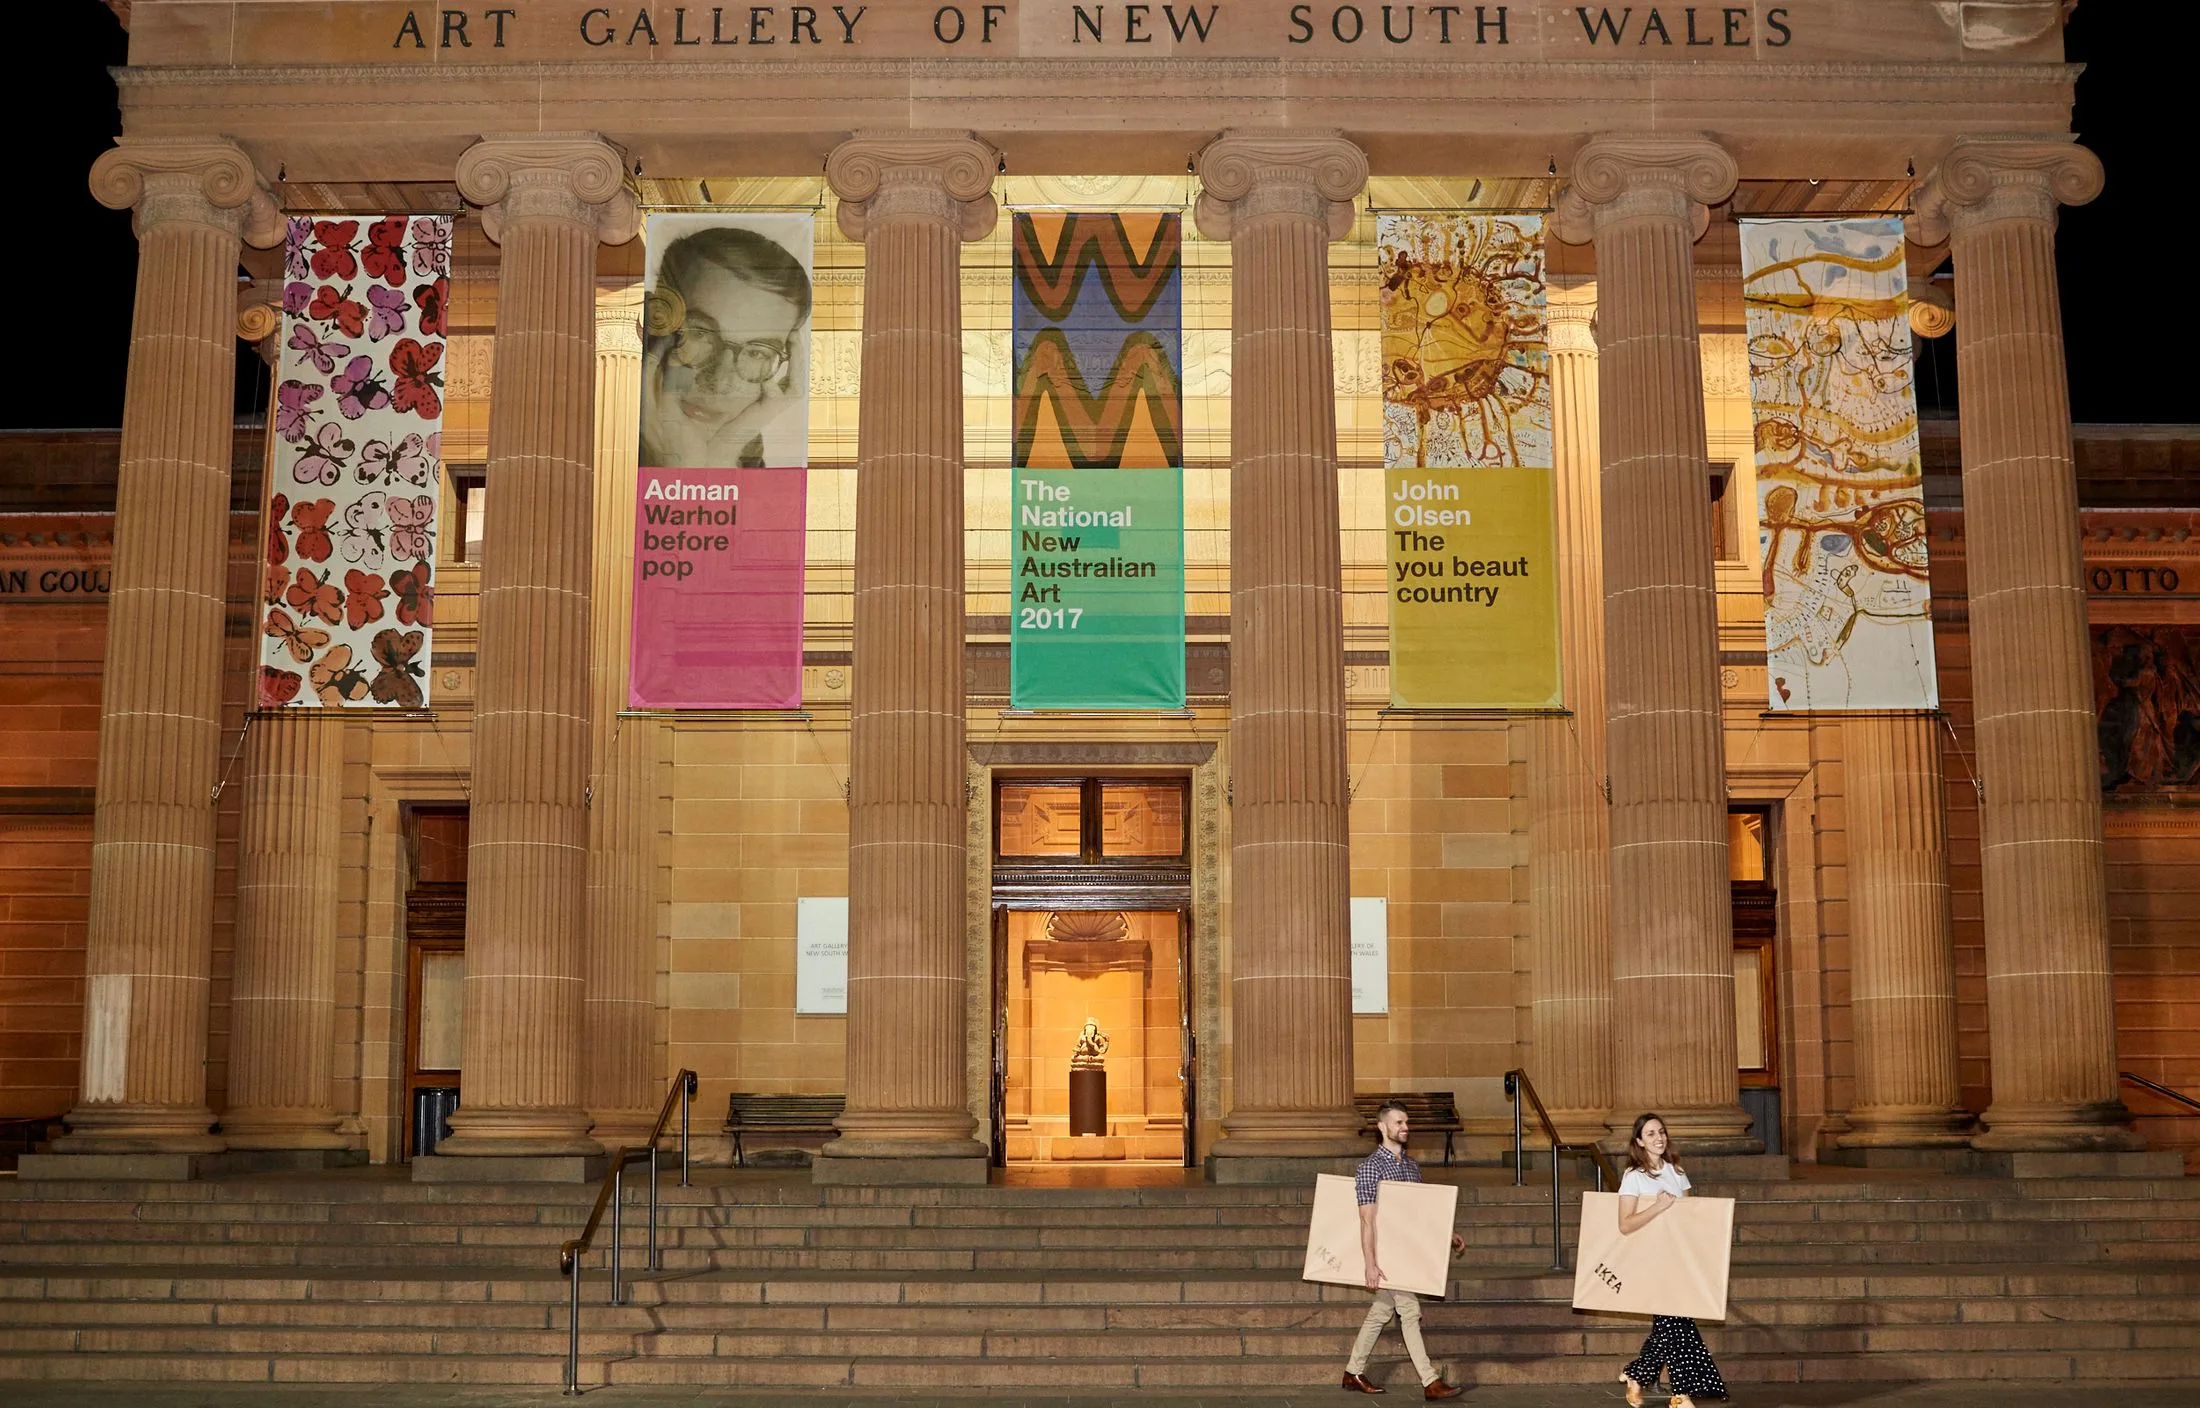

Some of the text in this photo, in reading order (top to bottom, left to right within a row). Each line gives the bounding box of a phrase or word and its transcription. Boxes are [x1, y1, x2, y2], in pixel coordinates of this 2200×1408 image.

[393, 5, 1793, 49] ART GALLERY OF NEW SOUTH WALES
[643, 479, 739, 500] Adman
[1020, 479, 1071, 502] The
[1393, 479, 1460, 501] John
[644, 505, 736, 525] Warhol
[1021, 504, 1132, 527] National
[1394, 504, 1471, 527] Olsen
[643, 530, 729, 550] before
[1021, 530, 1081, 552] New
[1394, 530, 1445, 551] The
[642, 560, 693, 580] pop
[1020, 556, 1156, 578] Australian
[1395, 556, 1529, 582] you beaut
[2084, 567, 2180, 592] OTTO
[1020, 581, 1061, 603] Art
[1396, 582, 1499, 607] country
[1020, 607, 1083, 630] 2017
[1594, 1263, 1623, 1294] IKEA
